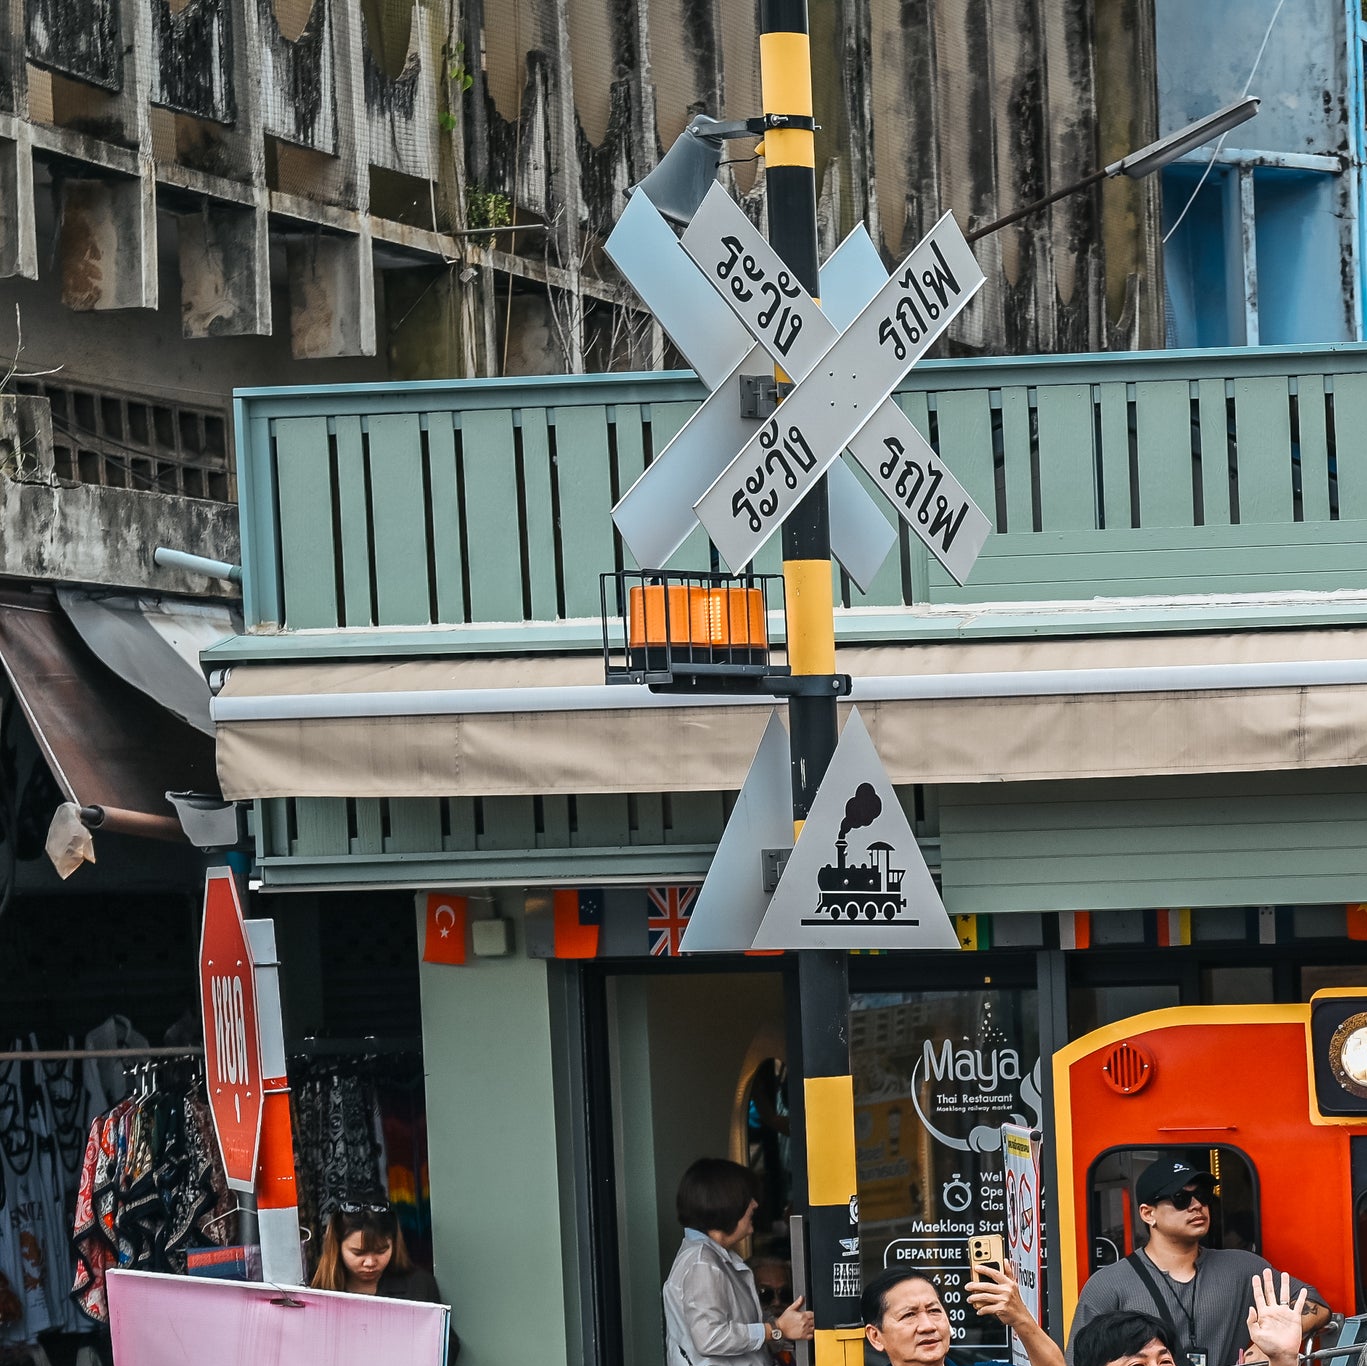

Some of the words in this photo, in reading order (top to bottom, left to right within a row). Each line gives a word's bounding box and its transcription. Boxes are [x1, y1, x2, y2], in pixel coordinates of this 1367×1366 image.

[716, 235, 802, 357] ระวัง
[879, 436, 970, 554] รถไฟ
[732, 419, 818, 533] ระวัง
[878, 238, 962, 361] รถไฟ
[923, 1039, 1022, 1092] Maya
[936, 1093, 958, 1104] Thai
[962, 1093, 1013, 1104] Restaurant
[911, 1219, 975, 1235] Maeklong
[896, 1248, 962, 1260] DEPARTURE
